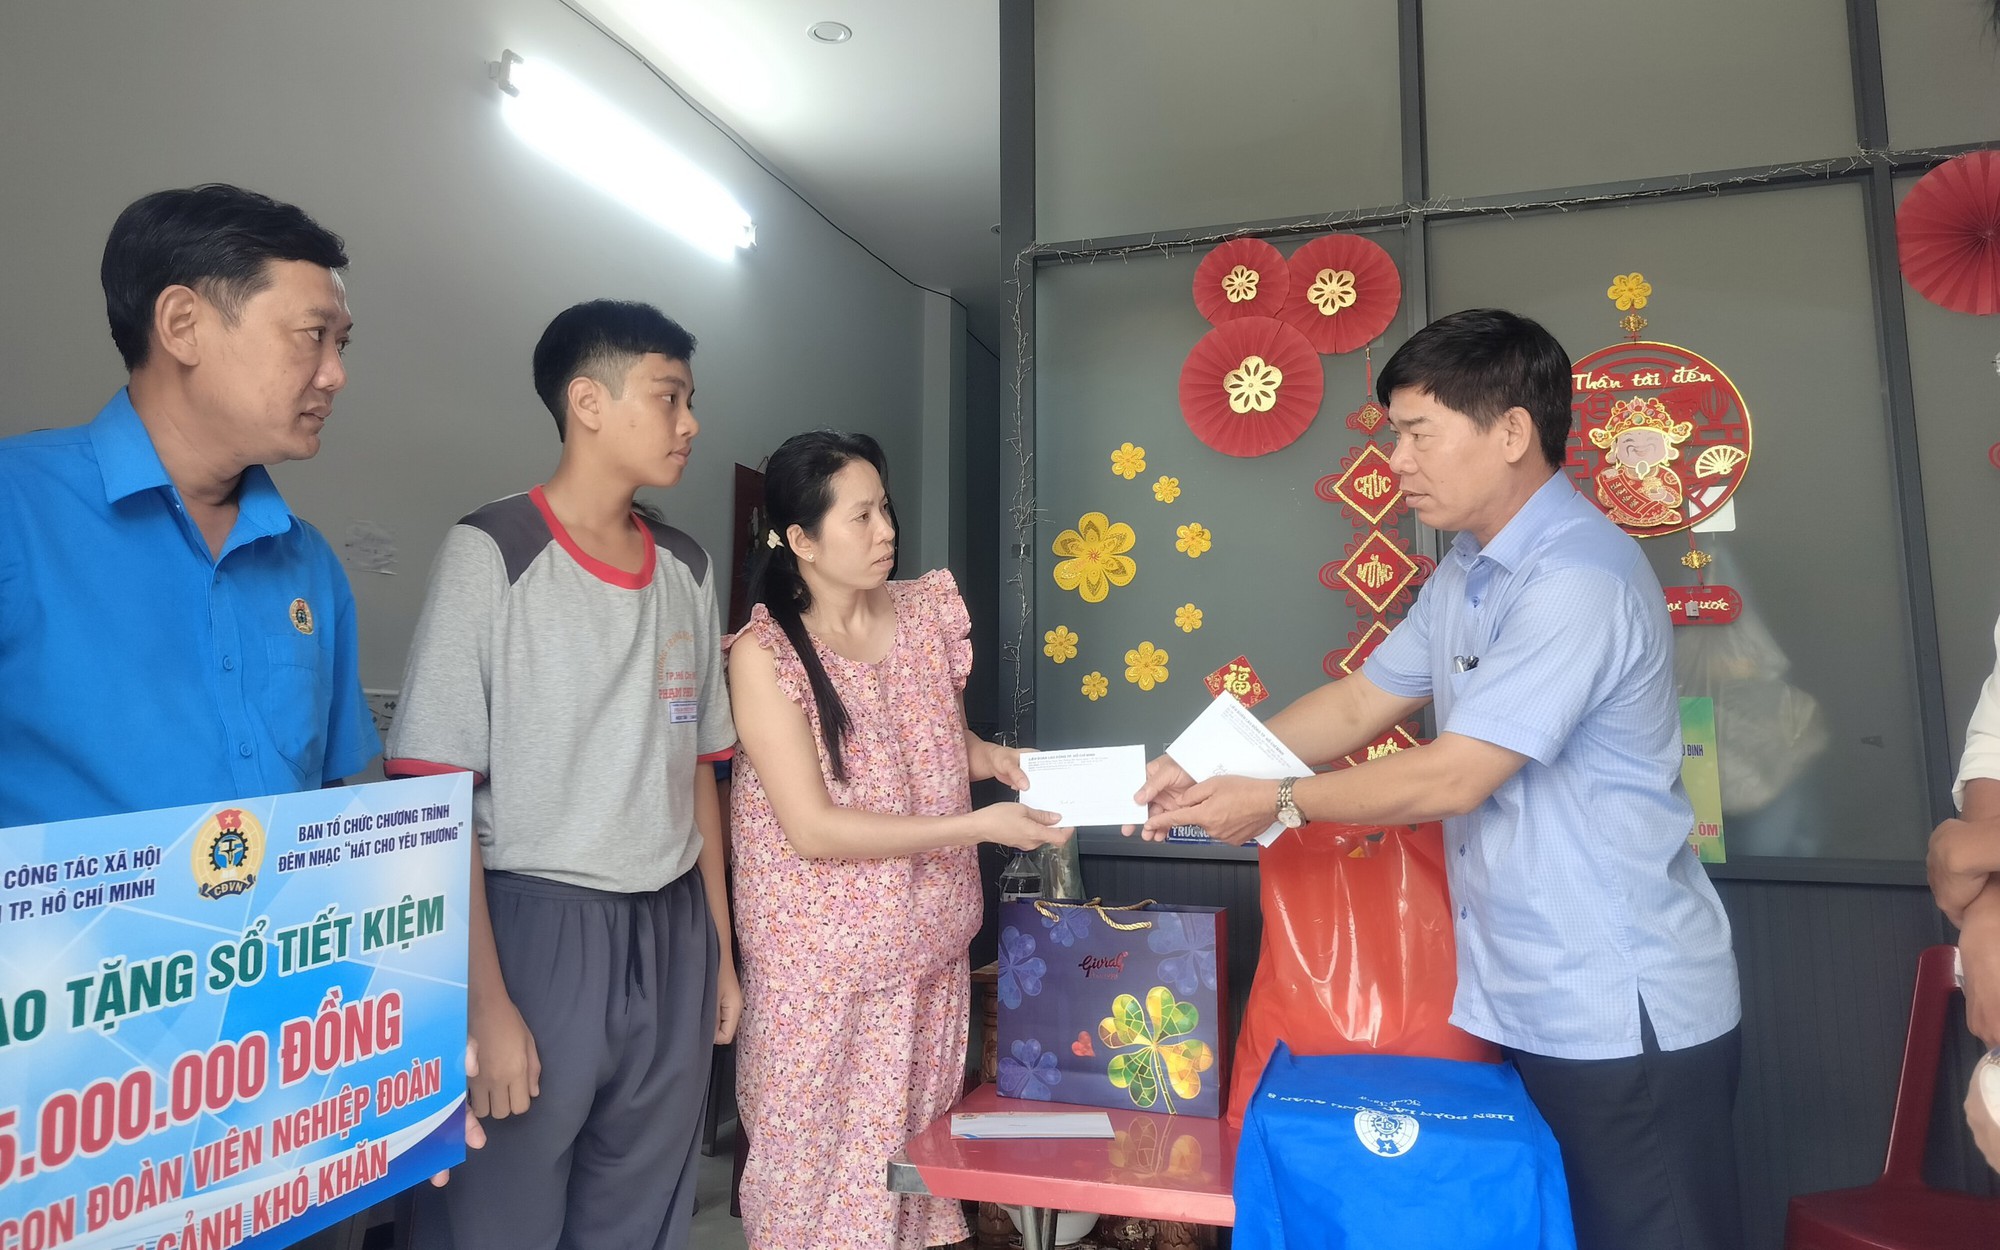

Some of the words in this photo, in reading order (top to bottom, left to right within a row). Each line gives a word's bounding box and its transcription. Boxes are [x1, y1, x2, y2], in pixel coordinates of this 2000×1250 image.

[1632, 372, 1661, 386] tài
[1672, 366, 1715, 384] đến
[1353, 468, 1392, 500] CHÚC
[1356, 553, 1394, 588] MỪNG
[1223, 663, 1252, 696] 福
[298, 824, 323, 842] BAN
[326, 814, 342, 838] TỔ
[343, 814, 373, 835] CHỨC
[376, 808, 418, 829] CHƯƠNG
[421, 803, 450, 822] TRÌNH
[1698, 821, 1719, 837] ÔM
[4, 864, 58, 890] CÔNG
[64, 855, 98, 880] TÁC
[104, 850, 128, 873] XÃ
[133, 845, 161, 871] HỘI
[278, 851, 305, 872] ĐÊM
[308, 846, 341, 867] NHẠC
[374, 838, 395, 855] CHO
[398, 831, 418, 850] YÊU
[9, 900, 35, 921] TP.
[41, 887, 67, 916] HỒ
[73, 883, 104, 910] CHÍ
[109, 878, 156, 903] MINH
[213, 880, 244, 896] CĐVN
[66, 953, 194, 1031] TẶNG
[209, 919, 267, 990] SỔ
[277, 906, 353, 974] TIẾT
[363, 894, 445, 951] KIỆM
[281, 989, 402, 1084] ĐỒNG
[87, 1159, 184, 1233] ĐOÀN
[193, 1126, 263, 1190] VIÊN
[272, 1086, 370, 1157] NGHIỆP
[376, 1058, 441, 1117] ĐOÀN
[253, 1166, 310, 1235] KHÓ
[317, 1139, 388, 1205] KHĂN
